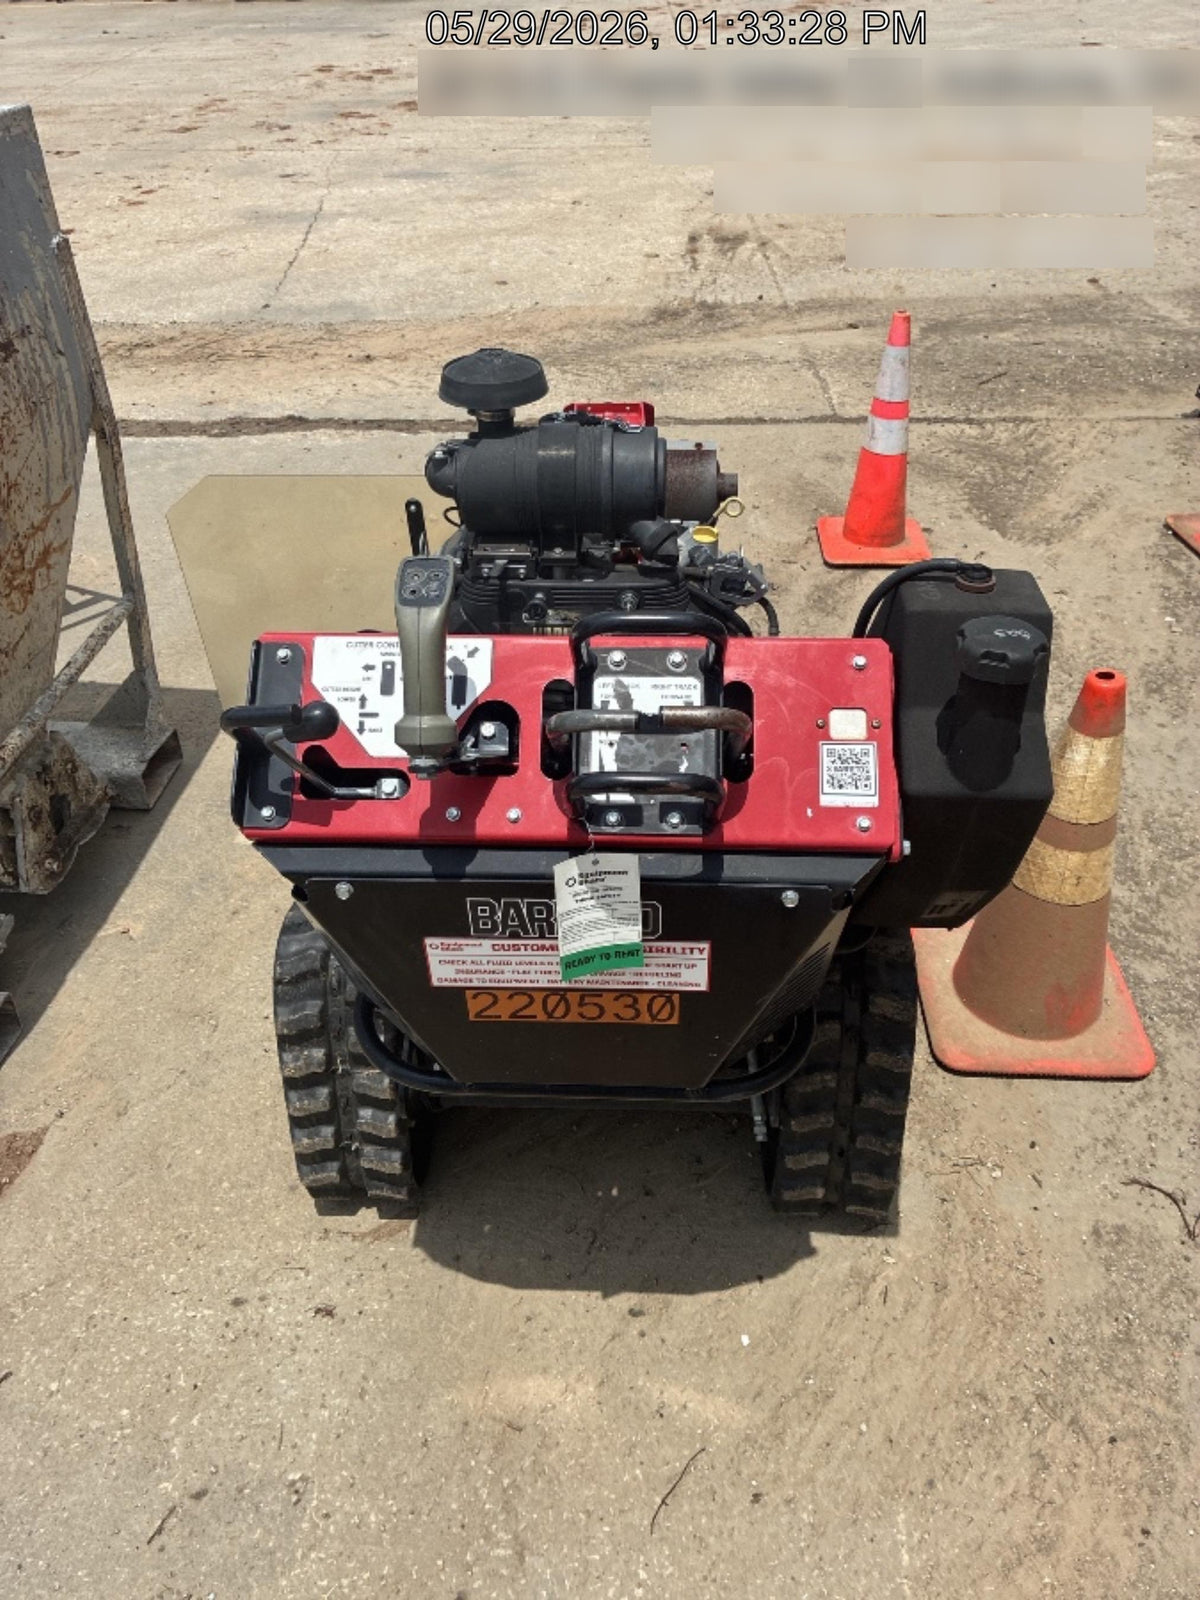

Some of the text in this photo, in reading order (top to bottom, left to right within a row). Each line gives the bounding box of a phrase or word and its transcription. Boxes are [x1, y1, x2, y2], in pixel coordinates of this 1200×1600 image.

[565, 954, 597, 971] READY
[600, 952, 611, 961] TO
[614, 949, 641, 959] RENT
[472, 991, 676, 1023] 220530
